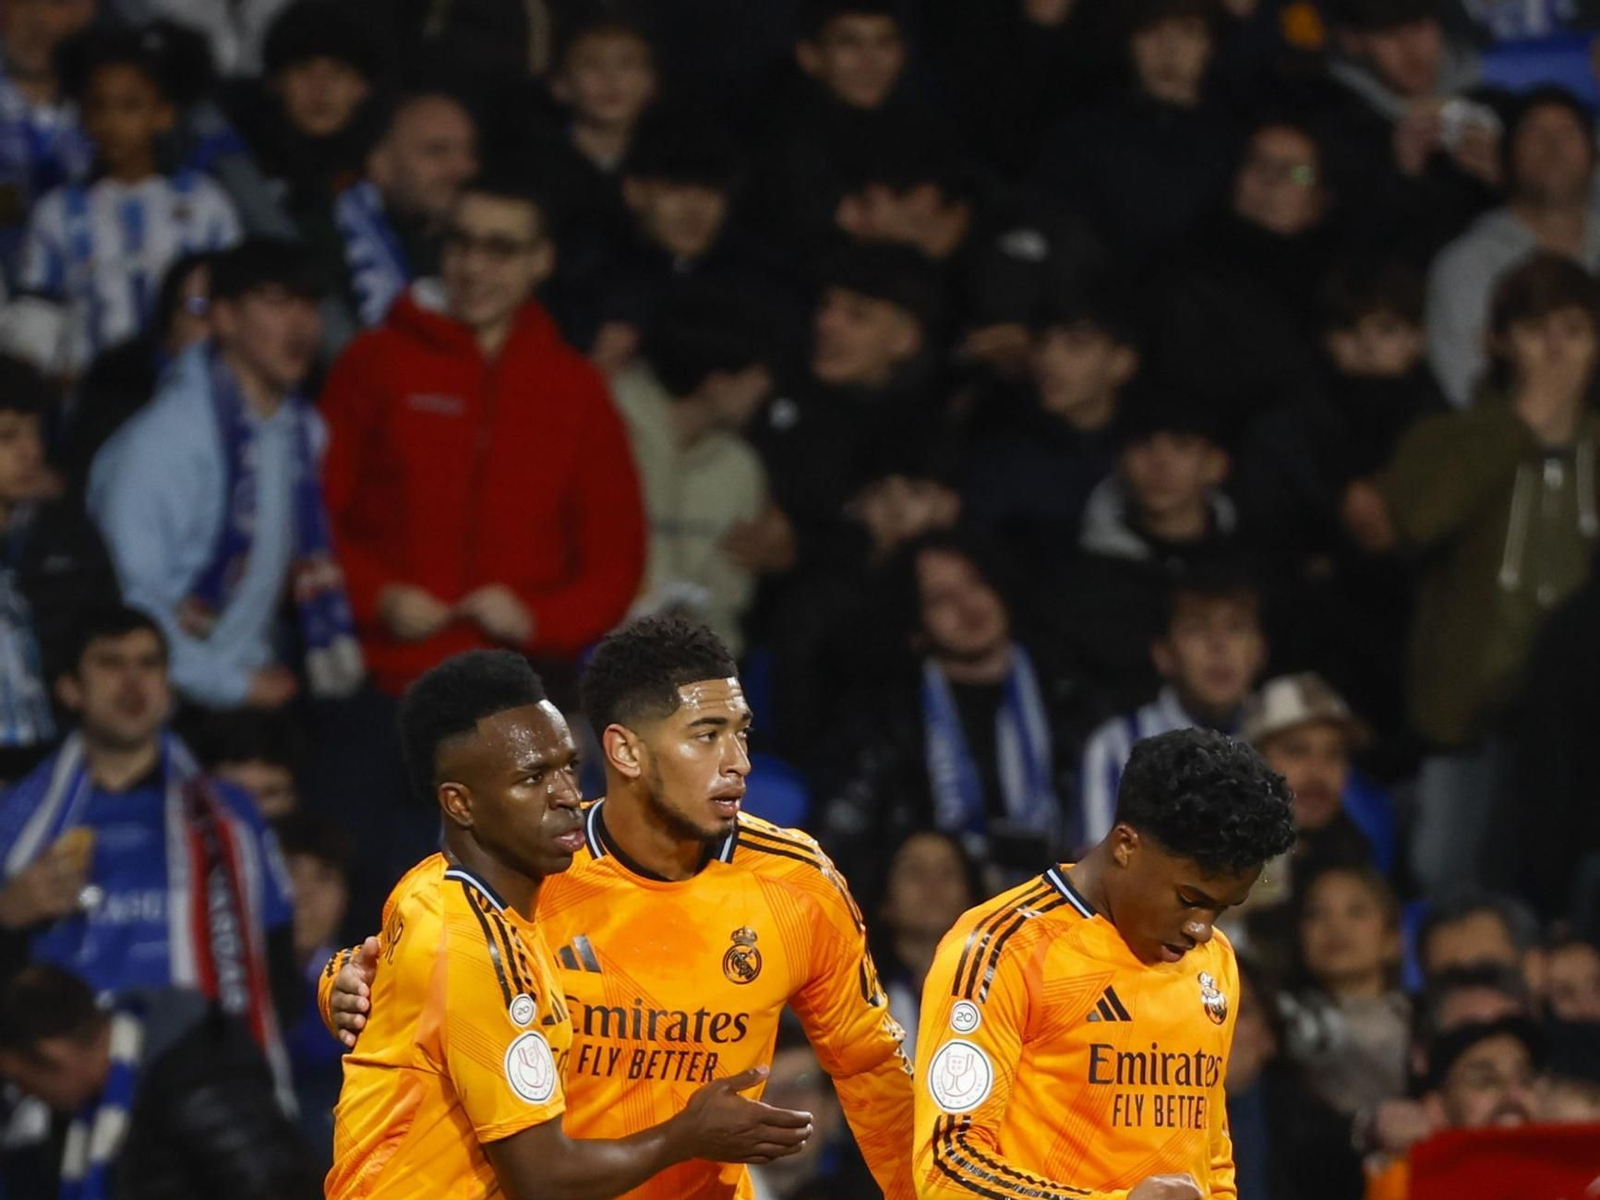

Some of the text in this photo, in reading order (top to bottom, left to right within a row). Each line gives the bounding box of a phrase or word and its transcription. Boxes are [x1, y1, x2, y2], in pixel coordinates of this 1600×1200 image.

[956, 1011, 973, 1023] 20
[577, 1043, 621, 1077] FLY
[628, 1048, 719, 1082] BETTER
[1088, 1042, 1222, 1088] Emirates
[1112, 1093, 1208, 1129] FLY BETTE
